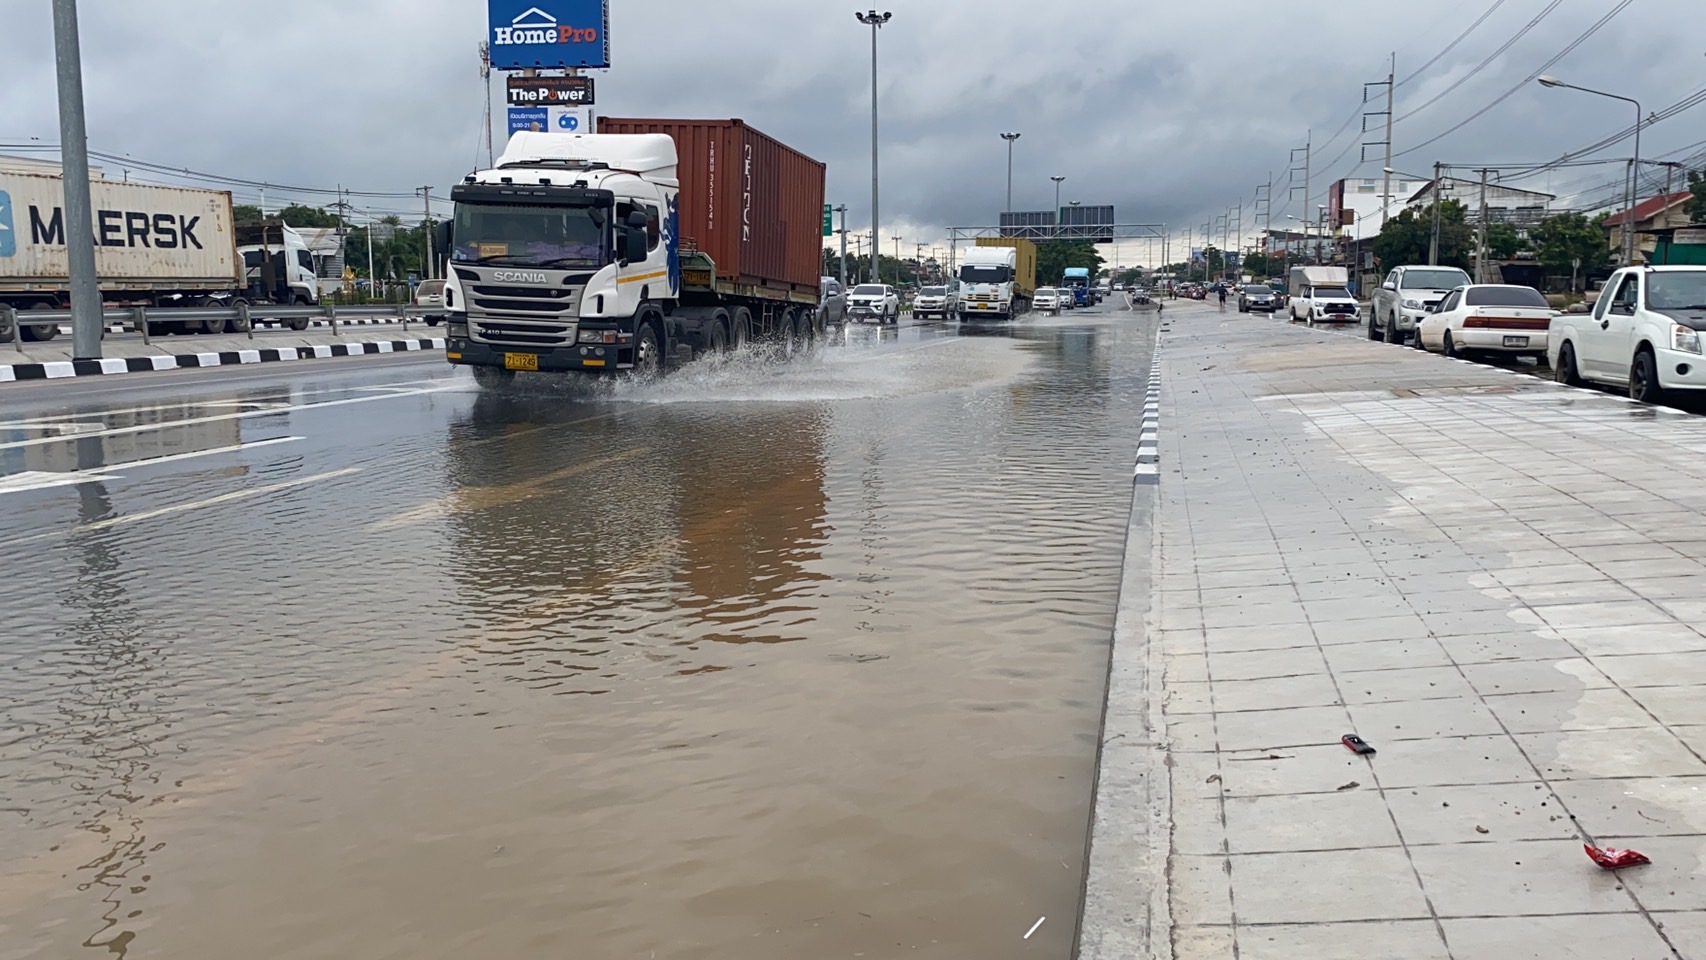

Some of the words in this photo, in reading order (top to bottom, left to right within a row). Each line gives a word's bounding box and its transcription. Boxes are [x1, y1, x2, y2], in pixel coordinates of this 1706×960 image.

[494, 25, 597, 45] HomePro
[509, 88, 537, 101] The
[538, 87, 585, 101] Power
[29, 205, 203, 249] MERSK
[493, 271, 548, 283] SCANIA
[506, 356, 536, 367] 71-1249
